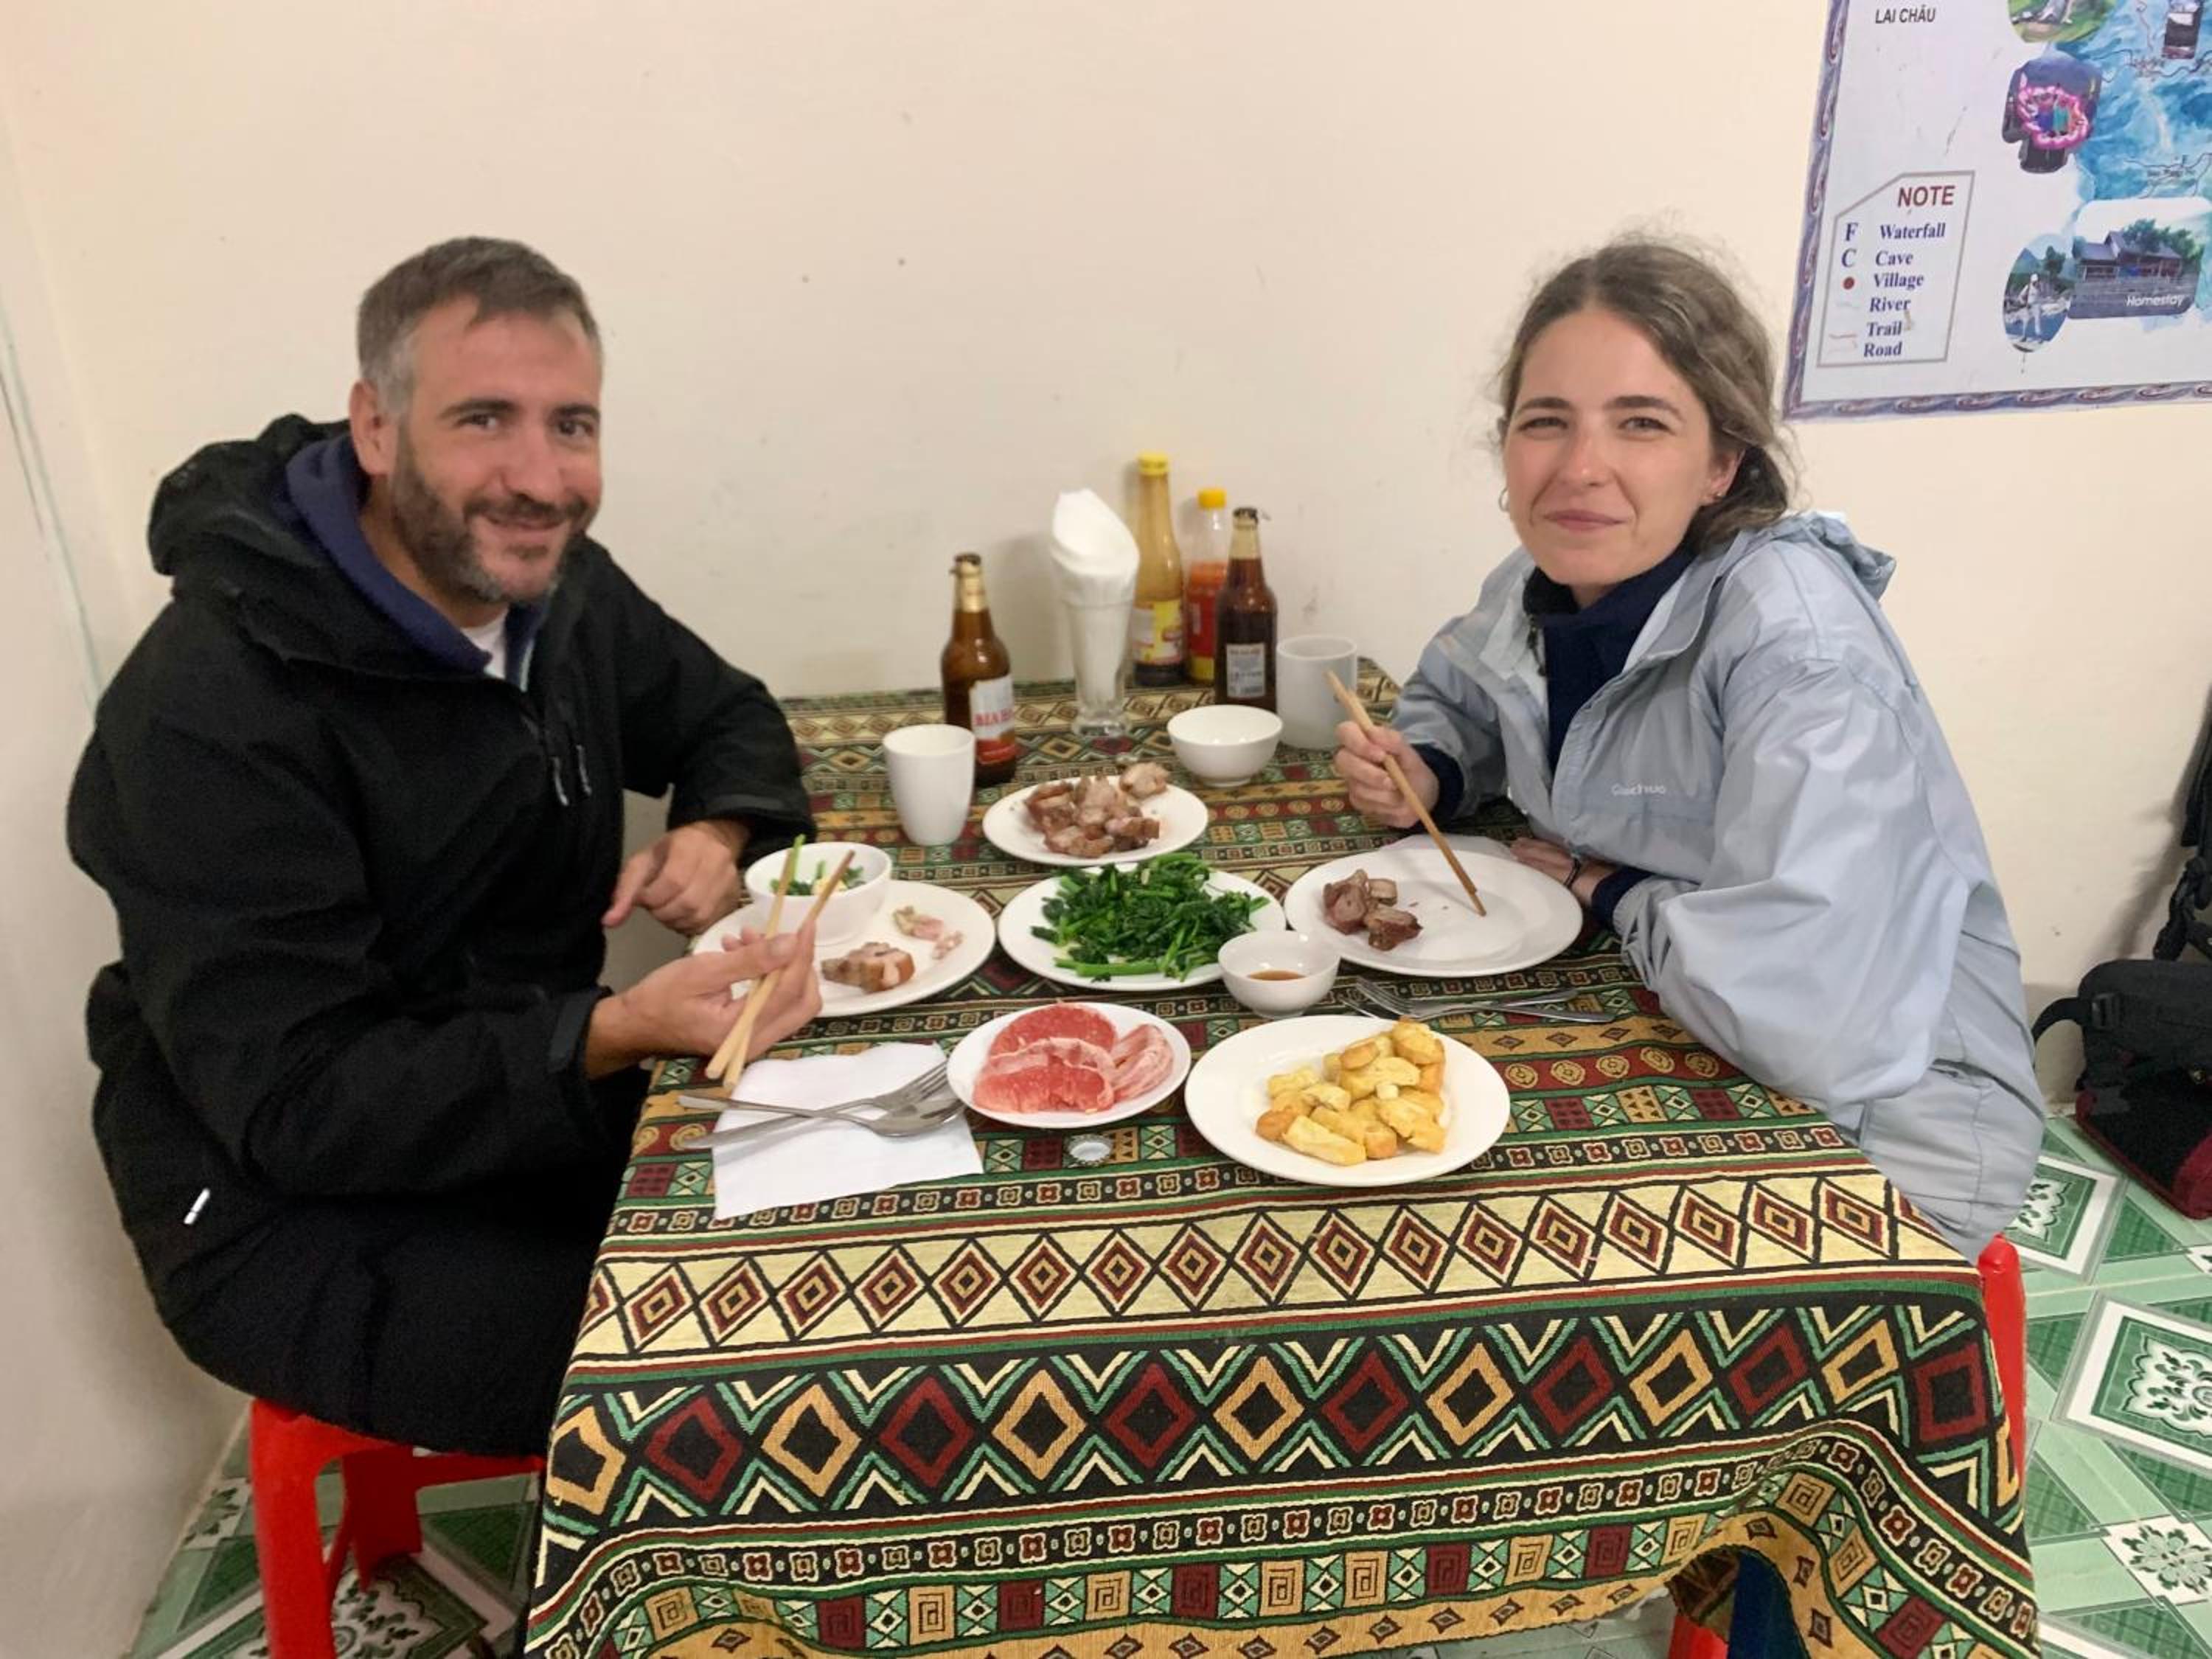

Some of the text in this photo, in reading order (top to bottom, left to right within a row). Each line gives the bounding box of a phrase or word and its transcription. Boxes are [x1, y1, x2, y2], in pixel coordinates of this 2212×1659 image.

[1875, 8, 1896, 24] LAI
[1897, 186, 1955, 207] NOTE
[1846, 222, 1946, 241] F Waterfall
[1841, 248, 1913, 268] C Cave
[1874, 273, 1924, 290] Village
[1869, 296, 1911, 313] River
[2126, 295, 2183, 307] Homestay
[1867, 321, 1902, 336] Trail
[1864, 341, 1902, 357] Road
